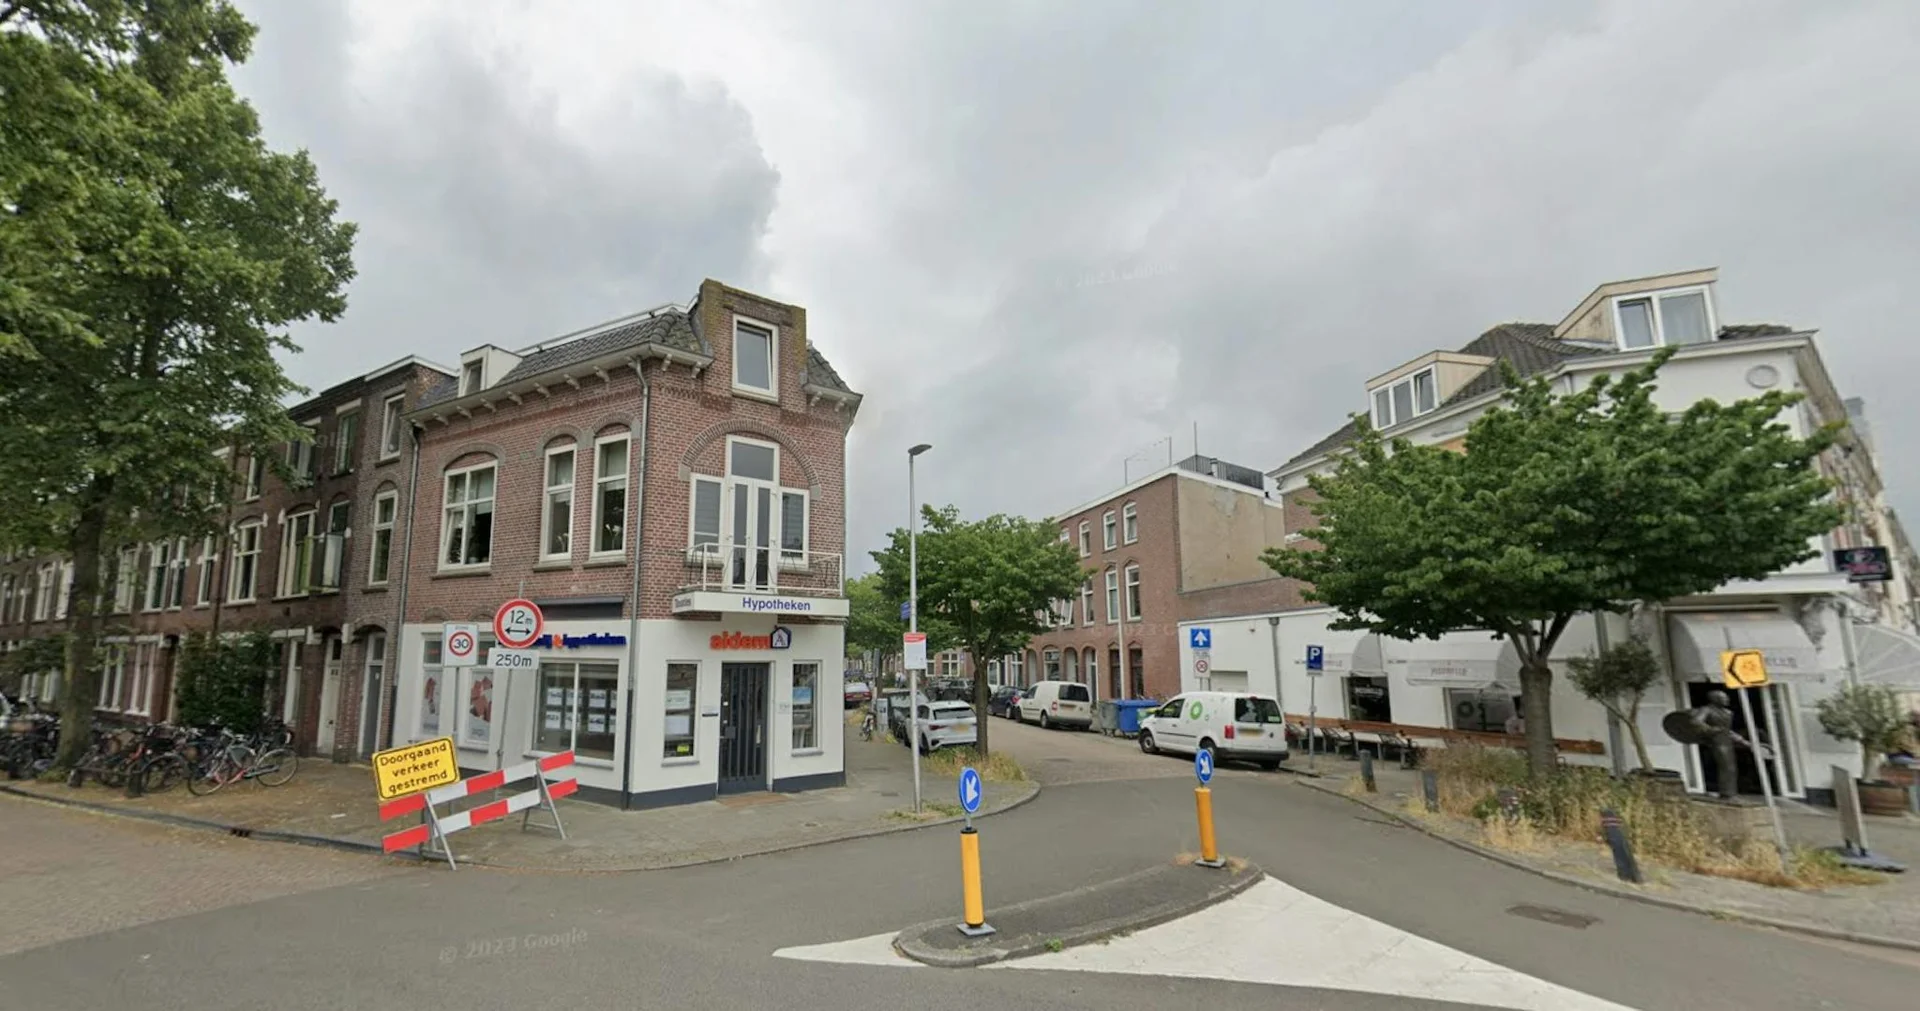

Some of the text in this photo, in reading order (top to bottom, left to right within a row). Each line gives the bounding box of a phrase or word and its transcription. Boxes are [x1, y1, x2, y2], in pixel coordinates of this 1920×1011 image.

[742, 597, 811, 611] Hypotheken
[454, 638, 469, 649] 30
[495, 654, 532, 667] 250m
[1310, 647, 1320, 660] P
[380, 743, 447, 766] Doorgaand
[392, 759, 440, 777] verkeer
[389, 770, 448, 794] gestremd
